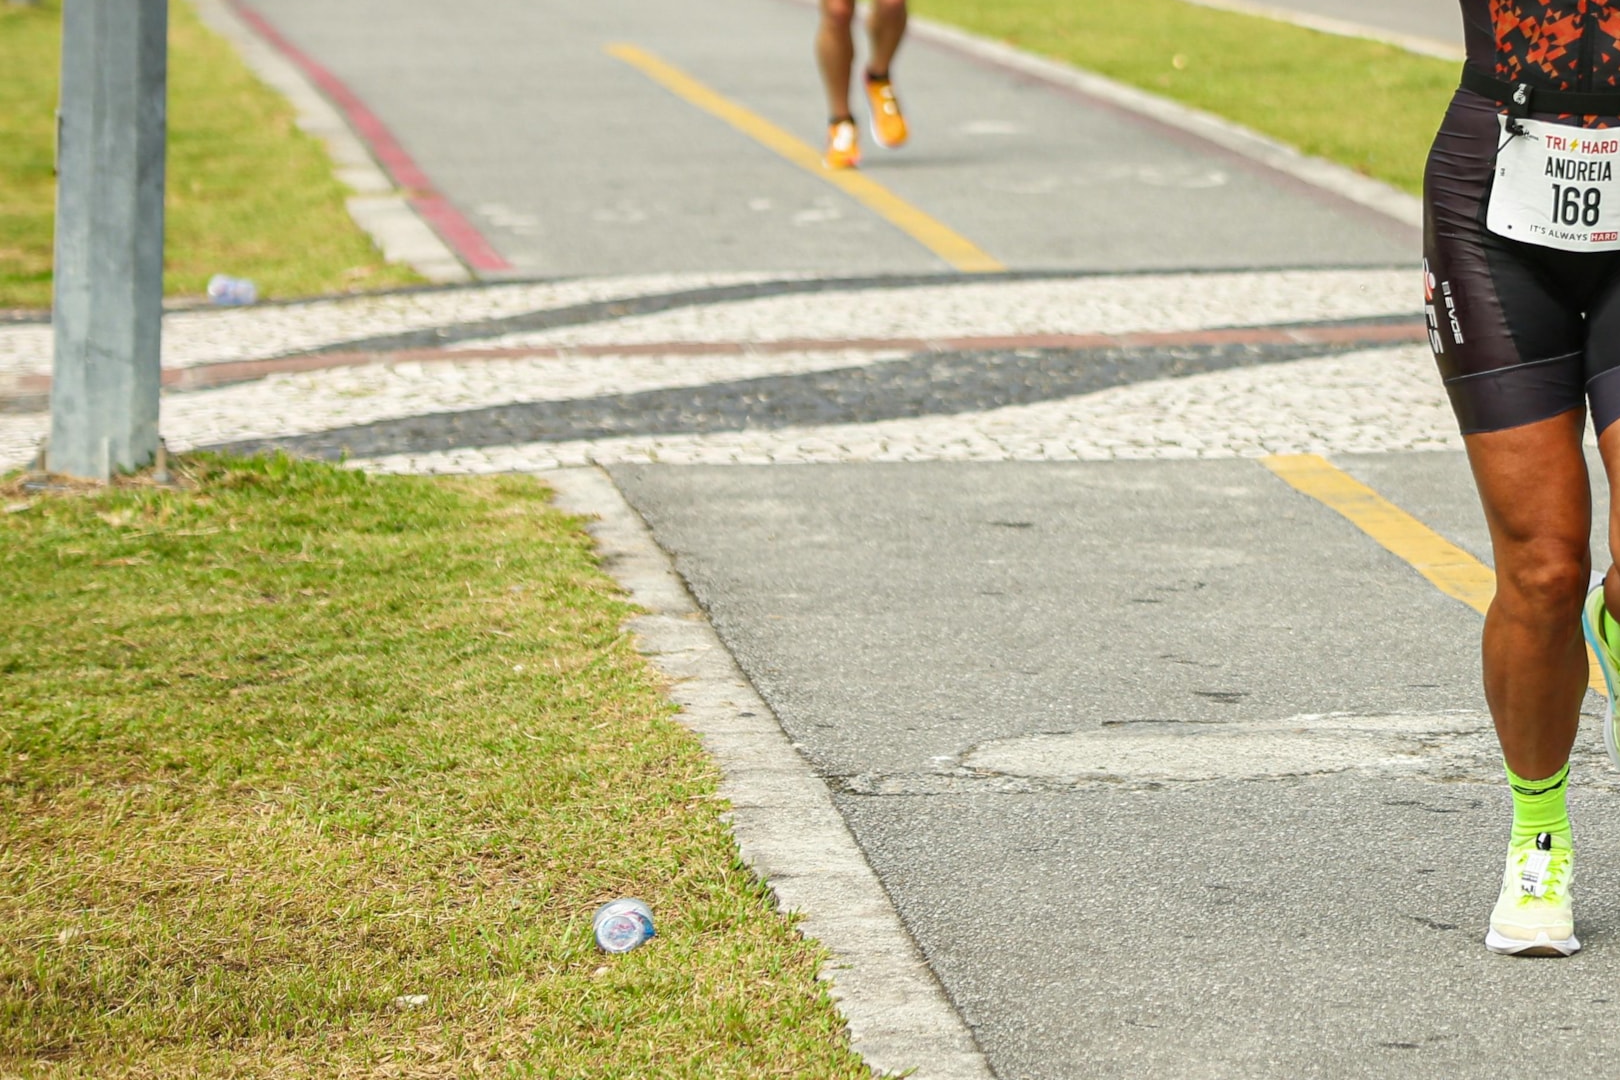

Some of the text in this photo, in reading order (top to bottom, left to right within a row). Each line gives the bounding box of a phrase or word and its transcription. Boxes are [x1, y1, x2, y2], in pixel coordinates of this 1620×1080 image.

[1545, 135, 1567, 151] TRI
[1581, 140, 1619, 154] HARD
[1545, 156, 1612, 181] ANDREIA
[1552, 183, 1602, 227] 168
[1530, 224, 1618, 241] IT'S ALWAYS HARD
